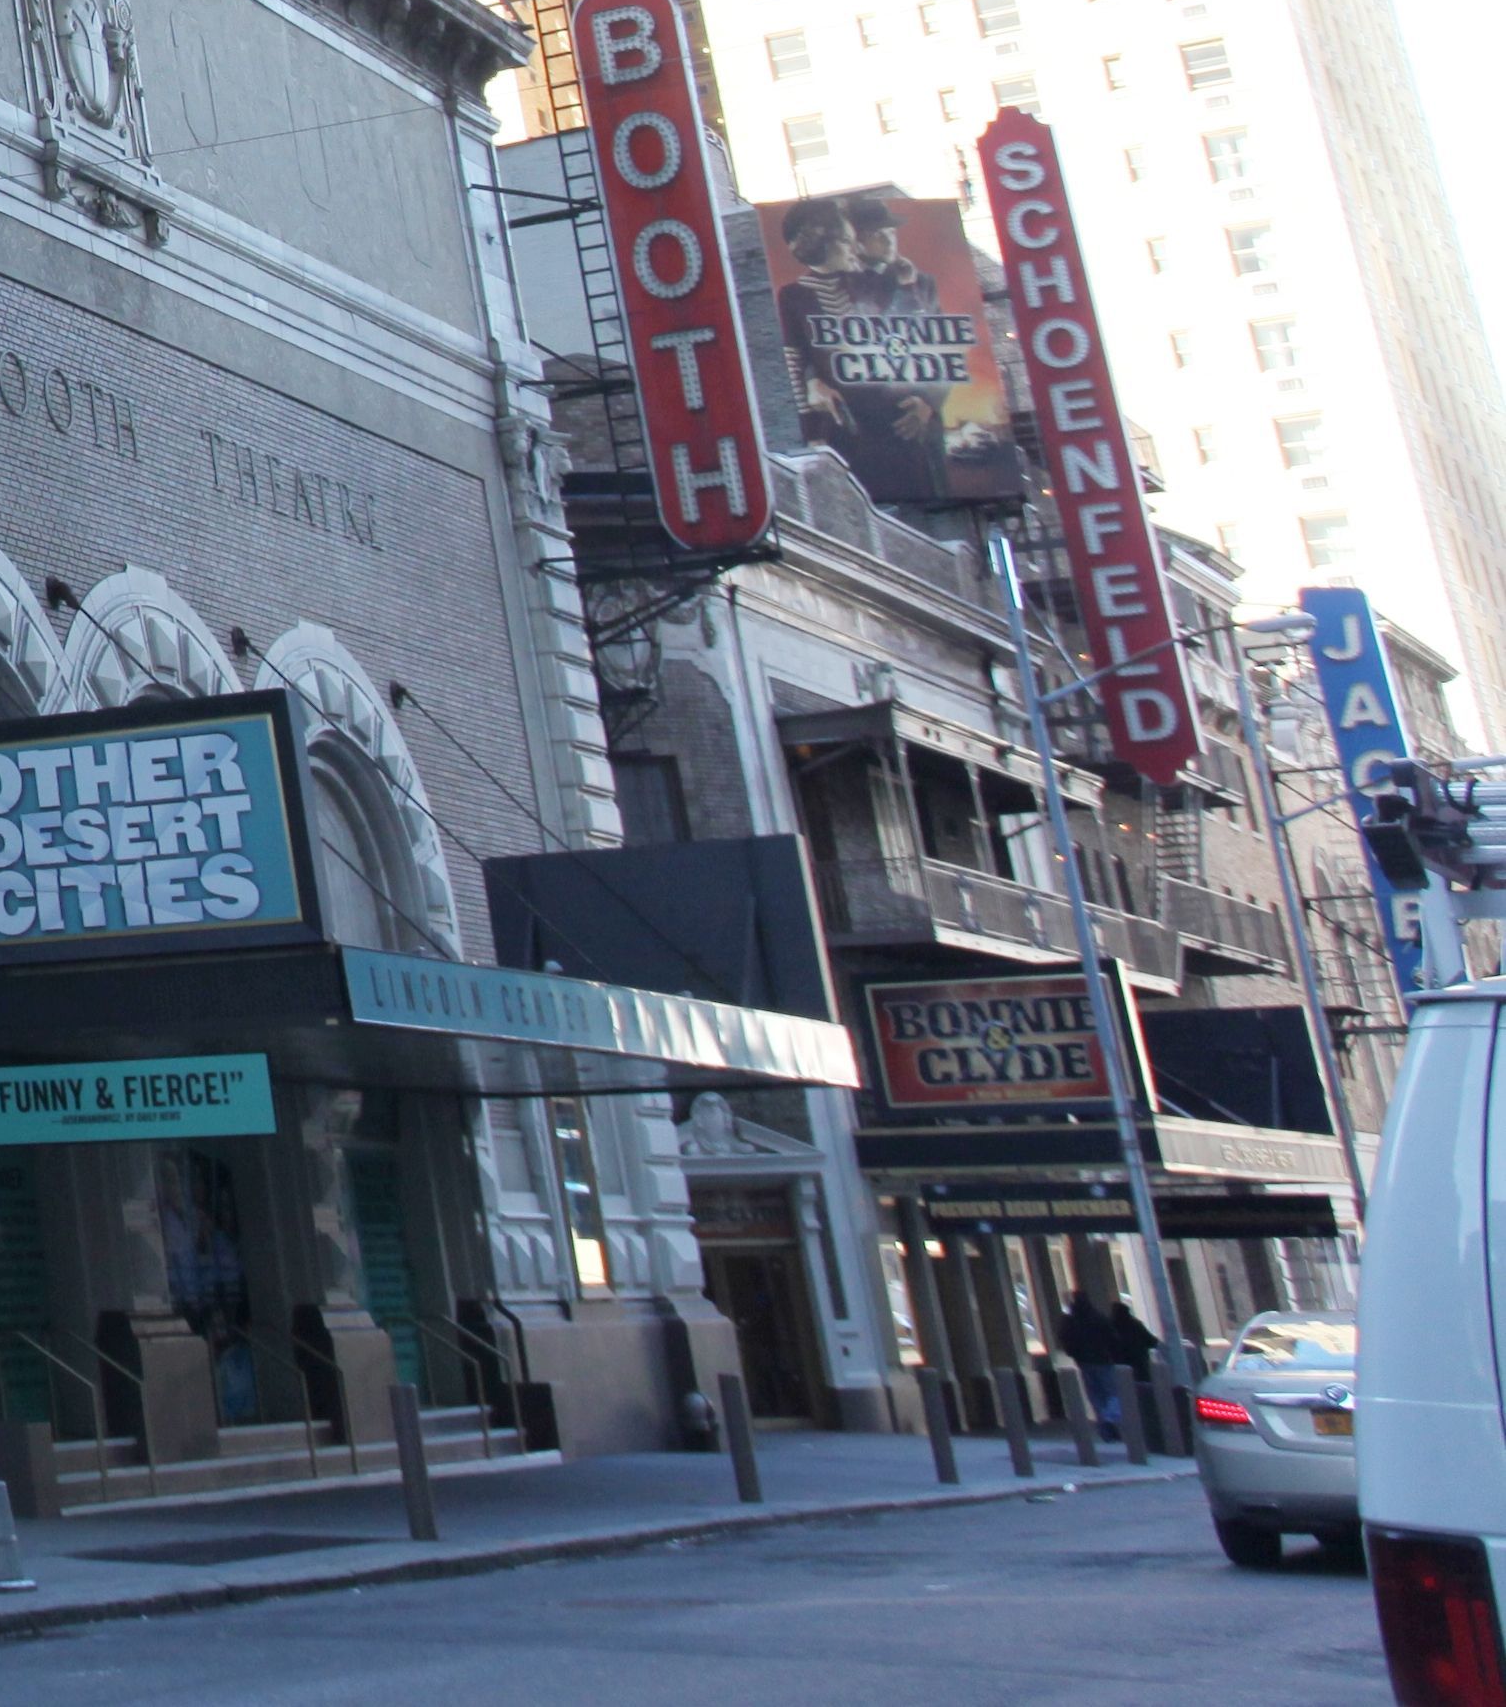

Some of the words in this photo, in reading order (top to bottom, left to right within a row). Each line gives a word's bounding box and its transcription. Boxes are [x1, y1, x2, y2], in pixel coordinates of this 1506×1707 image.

[591, 5, 749, 524] BOOTH
[805, 312, 977, 349] BONNIE
[884, 334, 910, 359] &
[830, 350, 971, 385] CLYDE
[994, 140, 1178, 743] SCHOENFELD
[200, 427, 386, 552] THEATRE
[370, 966, 483, 1019] LINCOLN
[889, 994, 1096, 1041] BONNIE
[917, 1043, 1095, 1085] CLYDE
[95, 1076, 115, 1110] &
